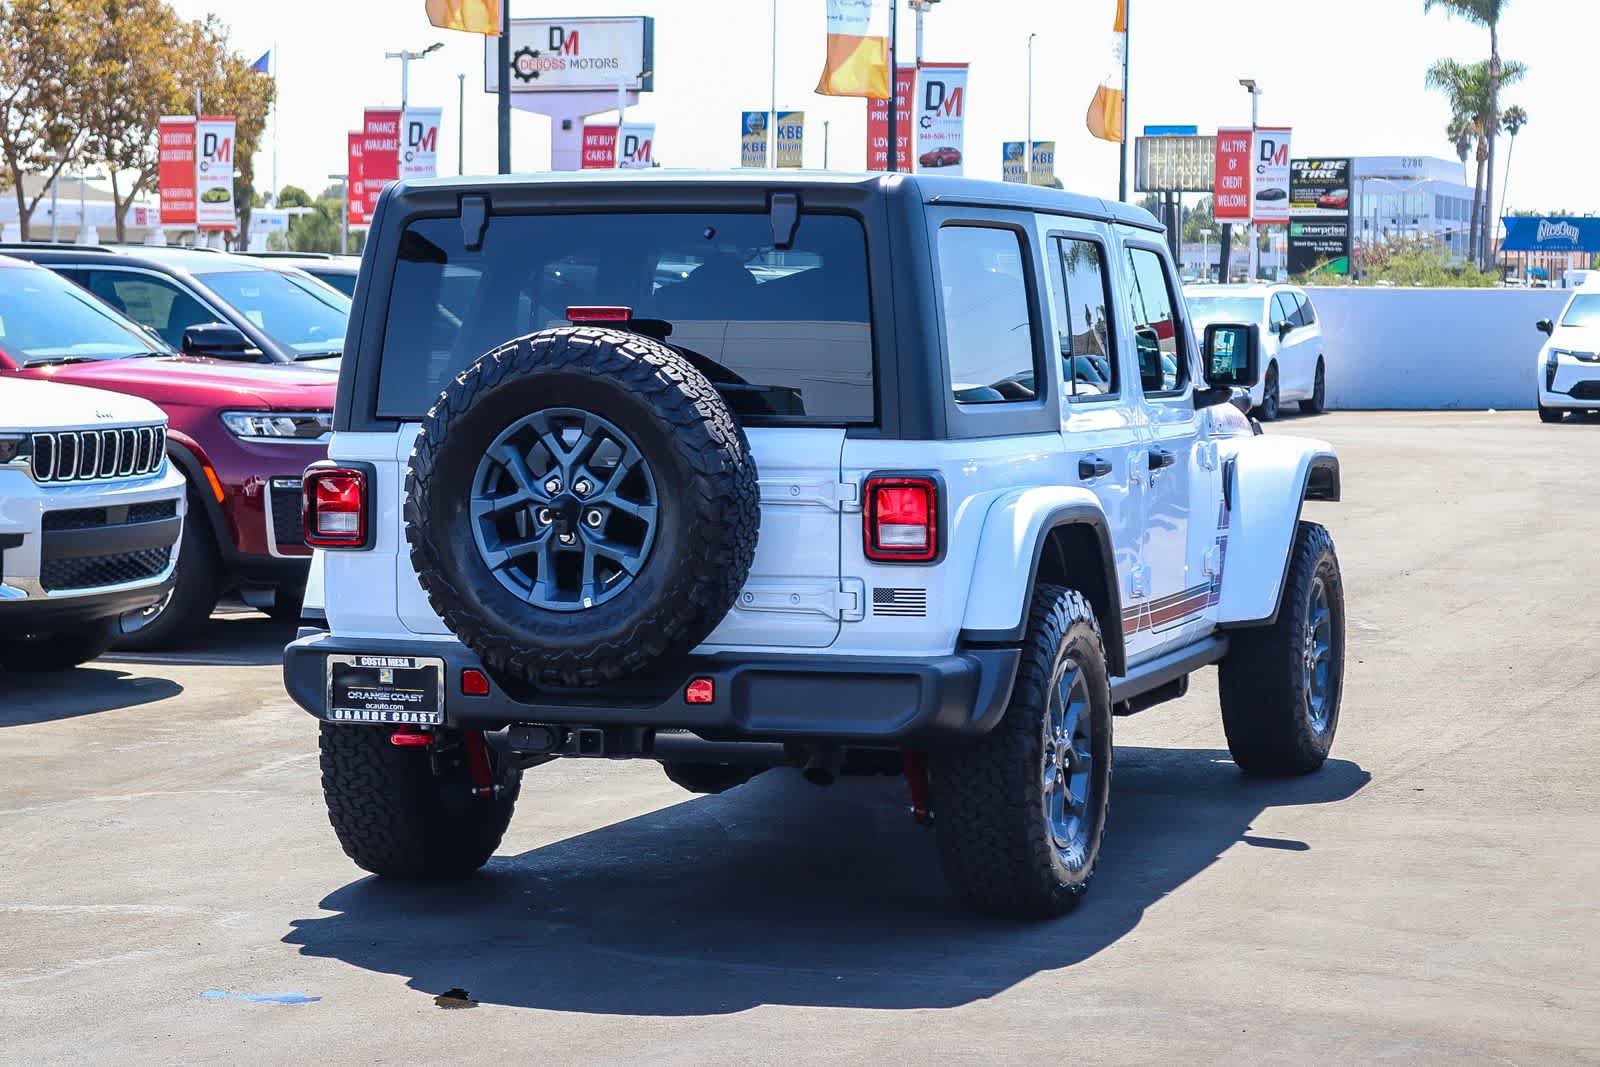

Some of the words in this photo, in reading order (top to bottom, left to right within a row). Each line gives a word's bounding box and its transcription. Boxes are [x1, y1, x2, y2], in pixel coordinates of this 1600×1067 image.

[549, 26, 579, 56] DM
[570, 57, 619, 70] MOTORS
[926, 80, 963, 117] DM
[871, 111, 910, 120] PRIOITY
[367, 122, 396, 133] FINANCE
[777, 126, 803, 140] KBB
[409, 121, 438, 152] DM
[586, 135, 598, 145] WE
[600, 135, 615, 146] BUY
[873, 137, 908, 147] LOST
[203, 132, 232, 162] DM
[365, 139, 398, 151] AVAILABLE
[624, 135, 652, 162] DM
[1221, 140, 1231, 152] ALL
[1232, 140, 1247, 152] TYPE
[586, 150, 605, 160] CARS
[876, 152, 906, 161] PRES
[1260, 139, 1289, 166] DM
[1229, 158, 1238, 170] OF
[1301, 170, 1338, 179] TIRE
[1222, 176, 1243, 189] CREDIT
[1218, 194, 1247, 207] WELCOME
[1295, 226, 1345, 235] enterprise
[361, 657, 386, 666] COSTA
[388, 658, 410, 667] MESA
[347, 691, 390, 701] ORANGE
[391, 692, 424, 702] COAST
[335, 710, 387, 720] ORANGE
[392, 712, 435, 722] COAST
